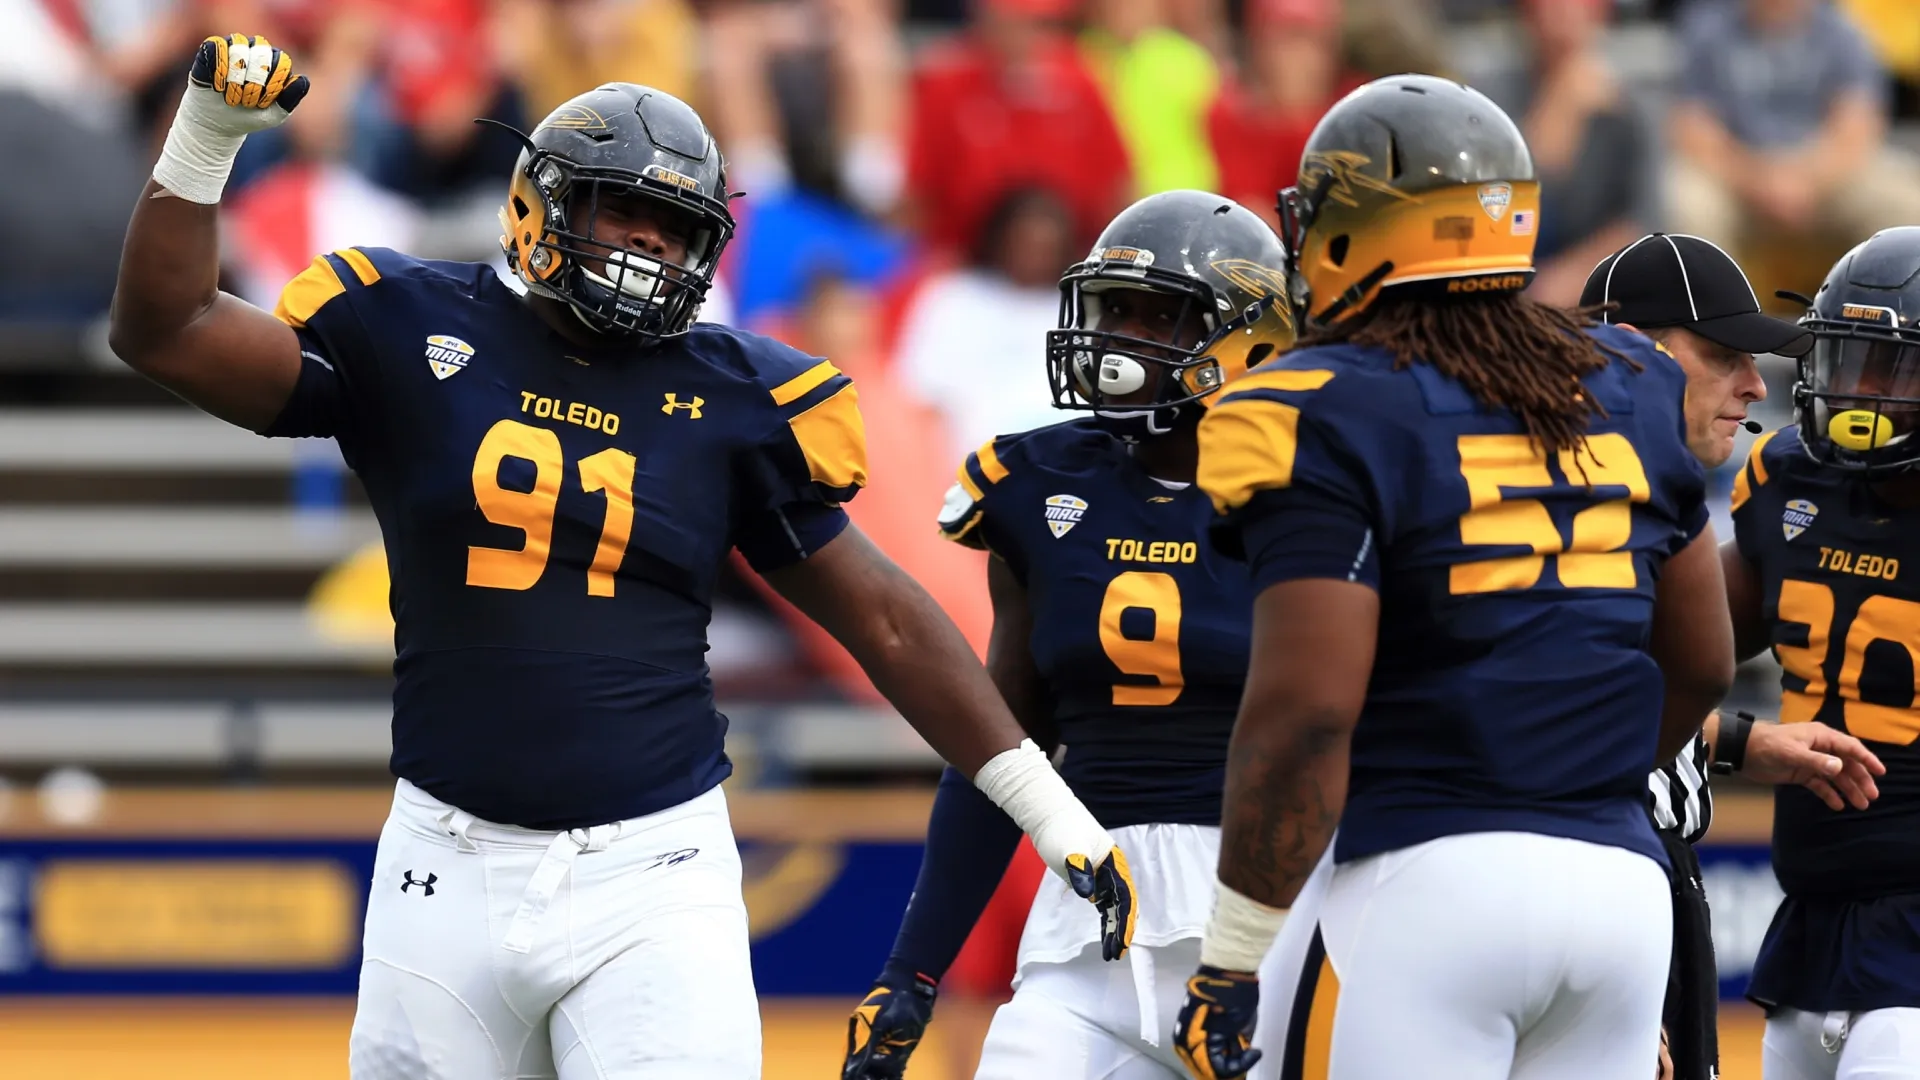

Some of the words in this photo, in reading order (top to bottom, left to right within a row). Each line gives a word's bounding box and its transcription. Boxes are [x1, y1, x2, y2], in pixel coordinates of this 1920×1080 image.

[657, 169, 680, 185] GLASS
[680, 177, 697, 191] CITY
[615, 302, 642, 318] Riddell
[425, 344, 471, 367] MAC
[520, 390, 620, 436] TOLEDO
[465, 418, 637, 598] 91
[1044, 506, 1084, 521] MAC
[1449, 432, 1651, 595] 52
[1105, 538, 1197, 564] TOLEDO
[1817, 546, 1899, 581] TOLEDO
[1098, 571, 1185, 706] 9
[1775, 578, 1920, 746] 30
